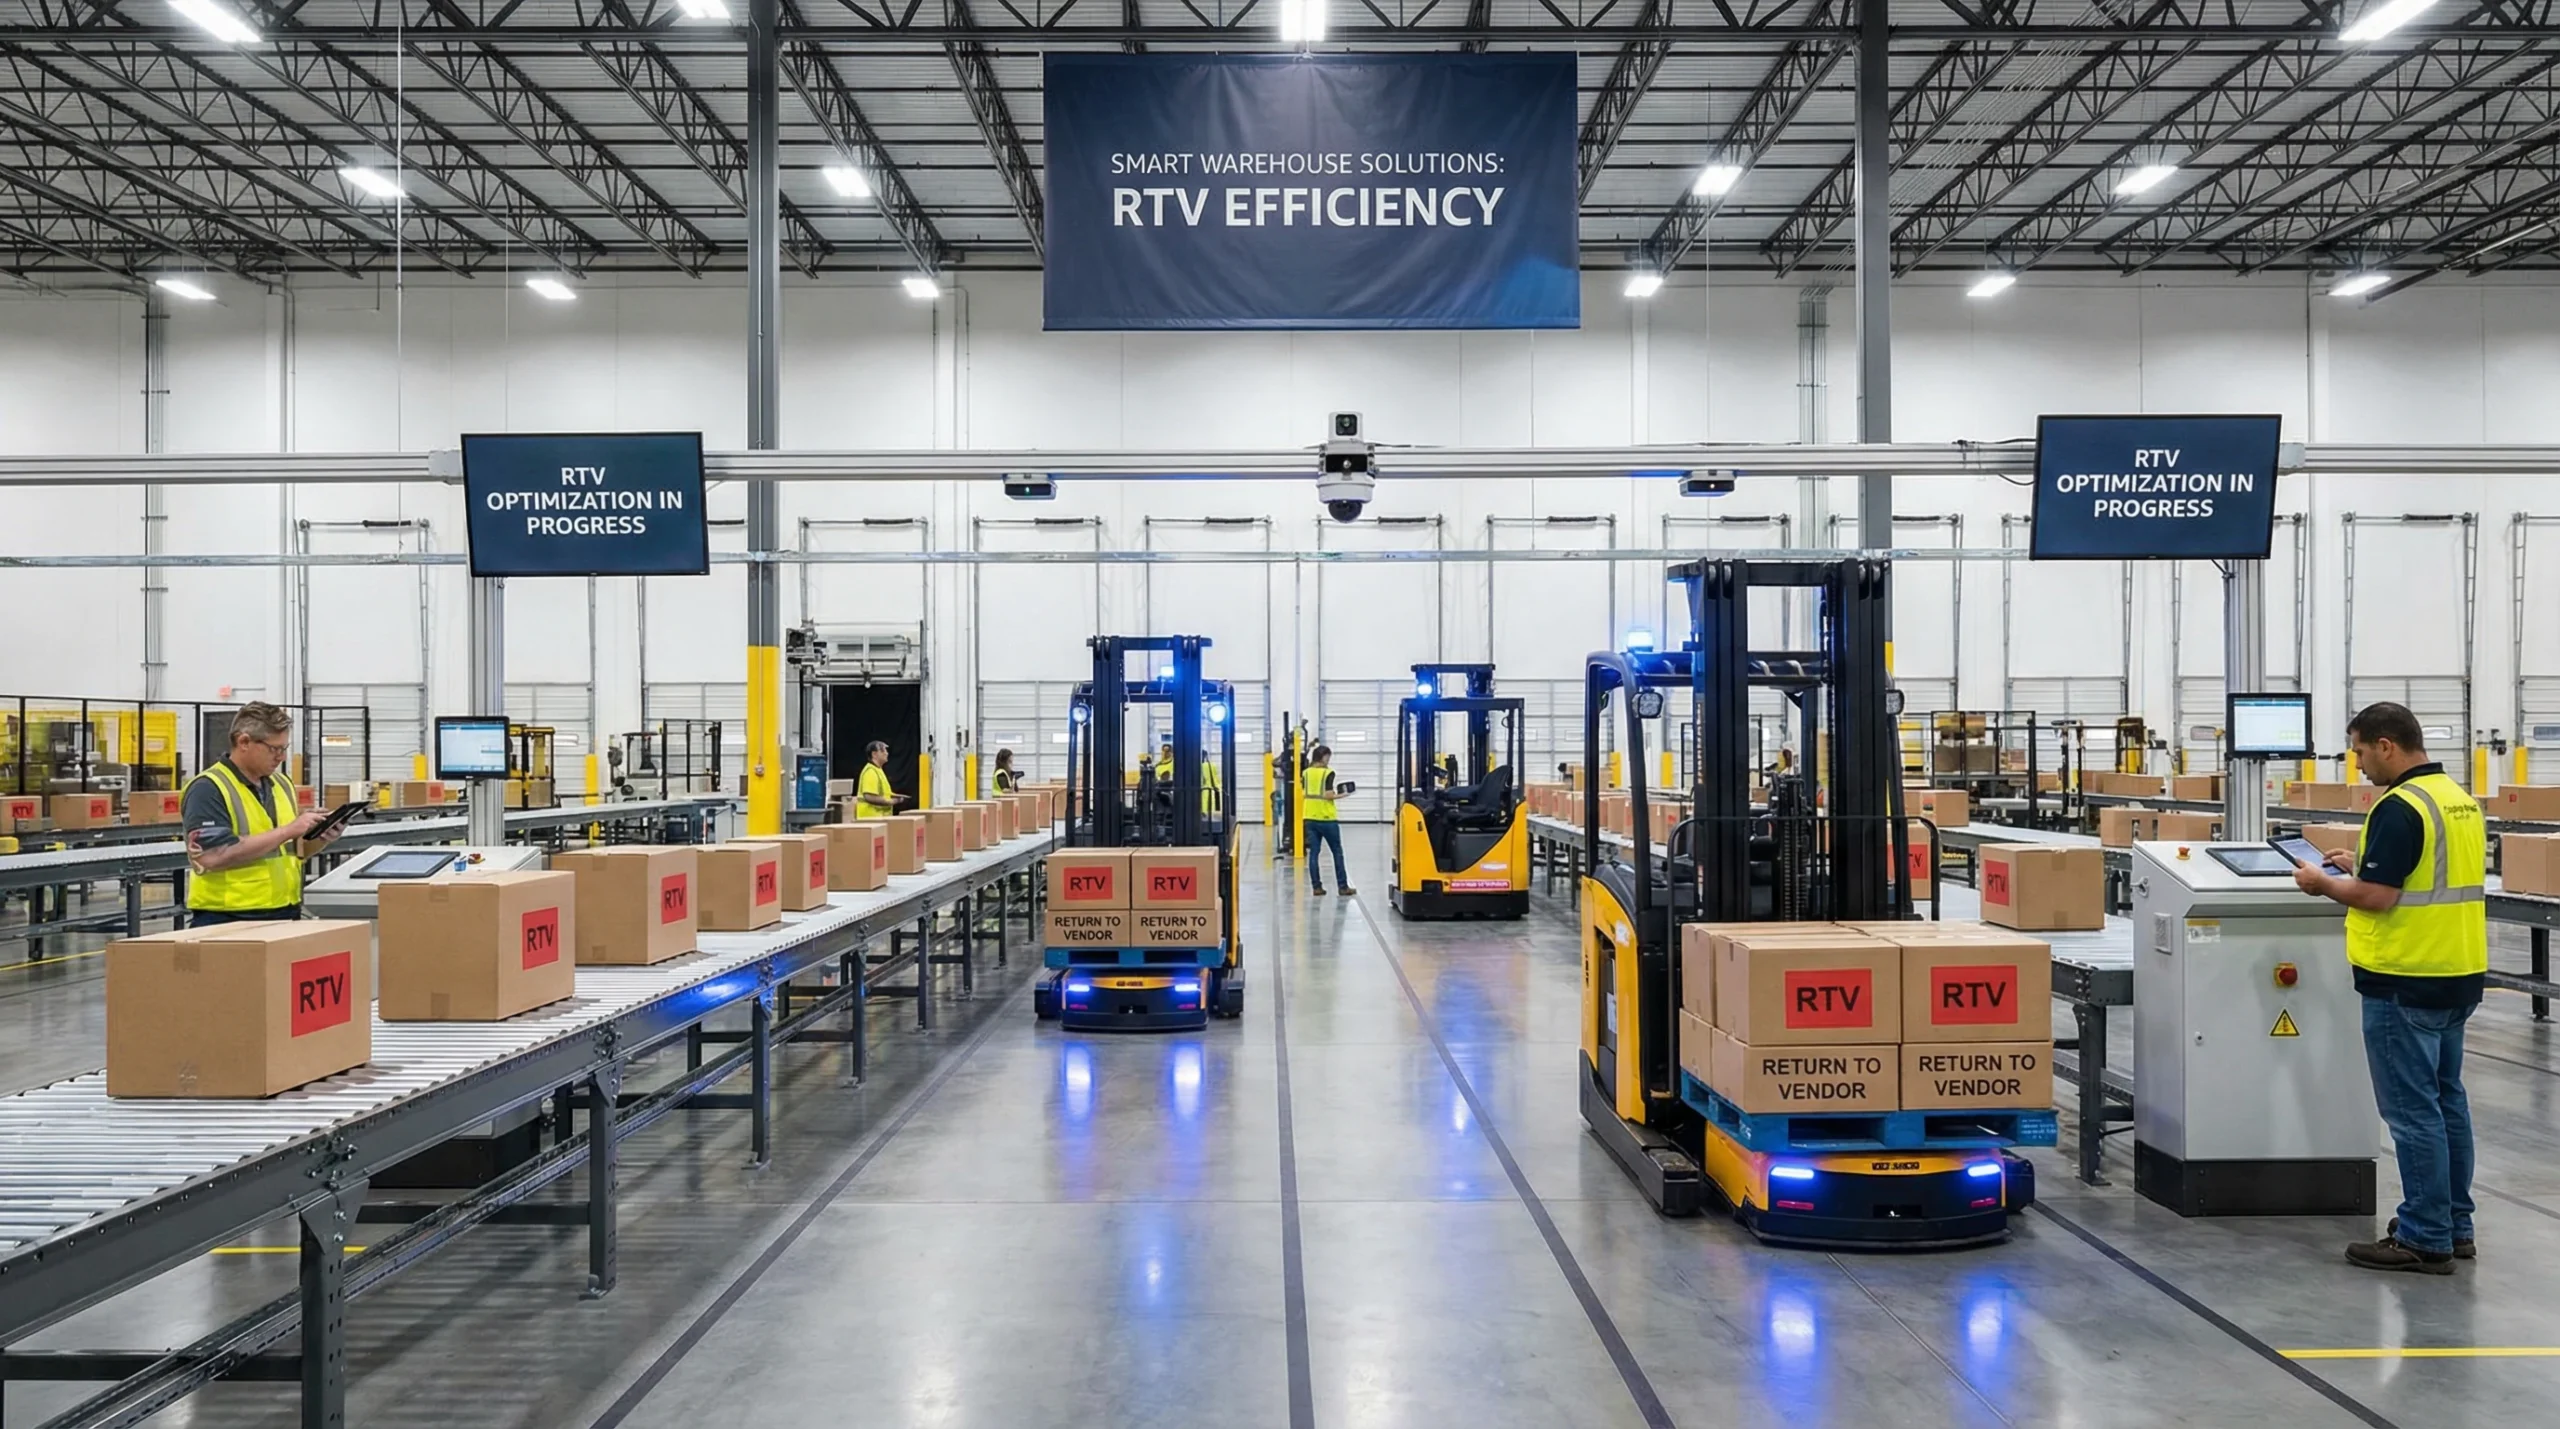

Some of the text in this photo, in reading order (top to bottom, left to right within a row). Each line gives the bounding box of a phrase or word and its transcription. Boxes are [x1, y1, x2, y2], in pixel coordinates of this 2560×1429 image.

[1111, 152, 1505, 175] SMART WAREHOUSE SOLUTIONS:
[1113, 186, 1506, 227] RTV EFFICIENCY
[2134, 449, 2181, 468] RTV
[561, 466, 606, 486] RTV
[2056, 473, 2254, 494] OPTIMIZATION IN
[486, 490, 683, 511] OPTIMIZATION IN
[2094, 498, 2214, 518] PROGRESS
[527, 516, 646, 535] PROGRESS
[758, 873, 775, 893] RTV
[1070, 876, 1106, 891] RTV
[1154, 876, 1190, 891] RTV
[1987, 874, 2006, 893] RTV
[664, 887, 685, 909] RTV
[1054, 916, 1121, 928] RETURN TO
[1140, 916, 1207, 928] RETURN TO
[526, 922, 556, 954] RTV
[1063, 929, 1113, 941] VENDOR
[1149, 929, 1198, 941] VENDOR
[299, 972, 345, 1014] RTV
[1796, 985, 1861, 1013] RTV
[1942, 981, 2007, 1009] RTV
[1762, 1057, 1881, 1076] RETURN TO
[1919, 1053, 2036, 1073] RETURN TO
[1778, 1082, 1867, 1101] VENDOR
[1934, 1078, 2022, 1097] VENDOR
